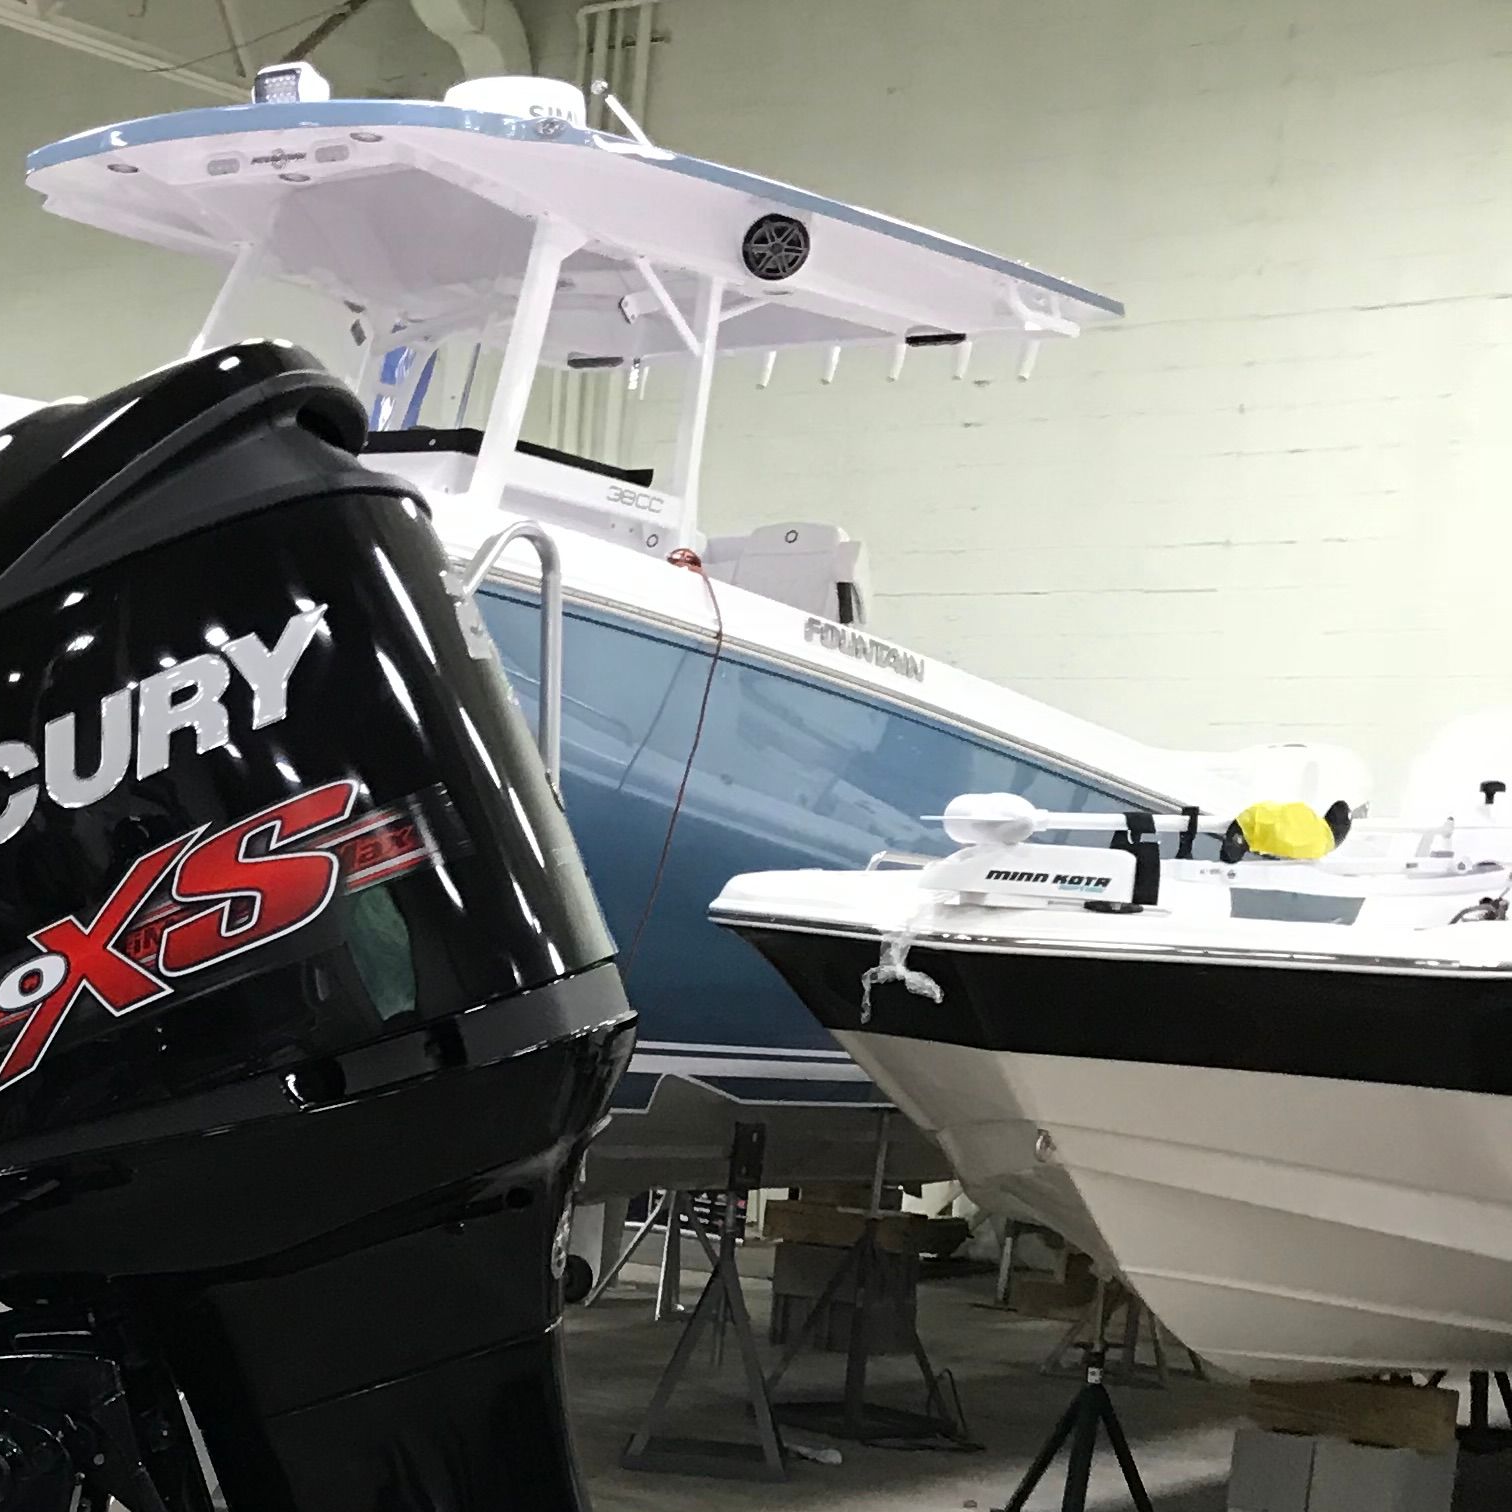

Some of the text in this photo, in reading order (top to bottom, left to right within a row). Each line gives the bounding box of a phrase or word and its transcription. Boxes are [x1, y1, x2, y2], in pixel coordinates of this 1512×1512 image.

[606, 485, 665, 513] 38CC
[803, 617, 925, 682] FOUNTAIN
[1051, 874, 1112, 888] KOTA
